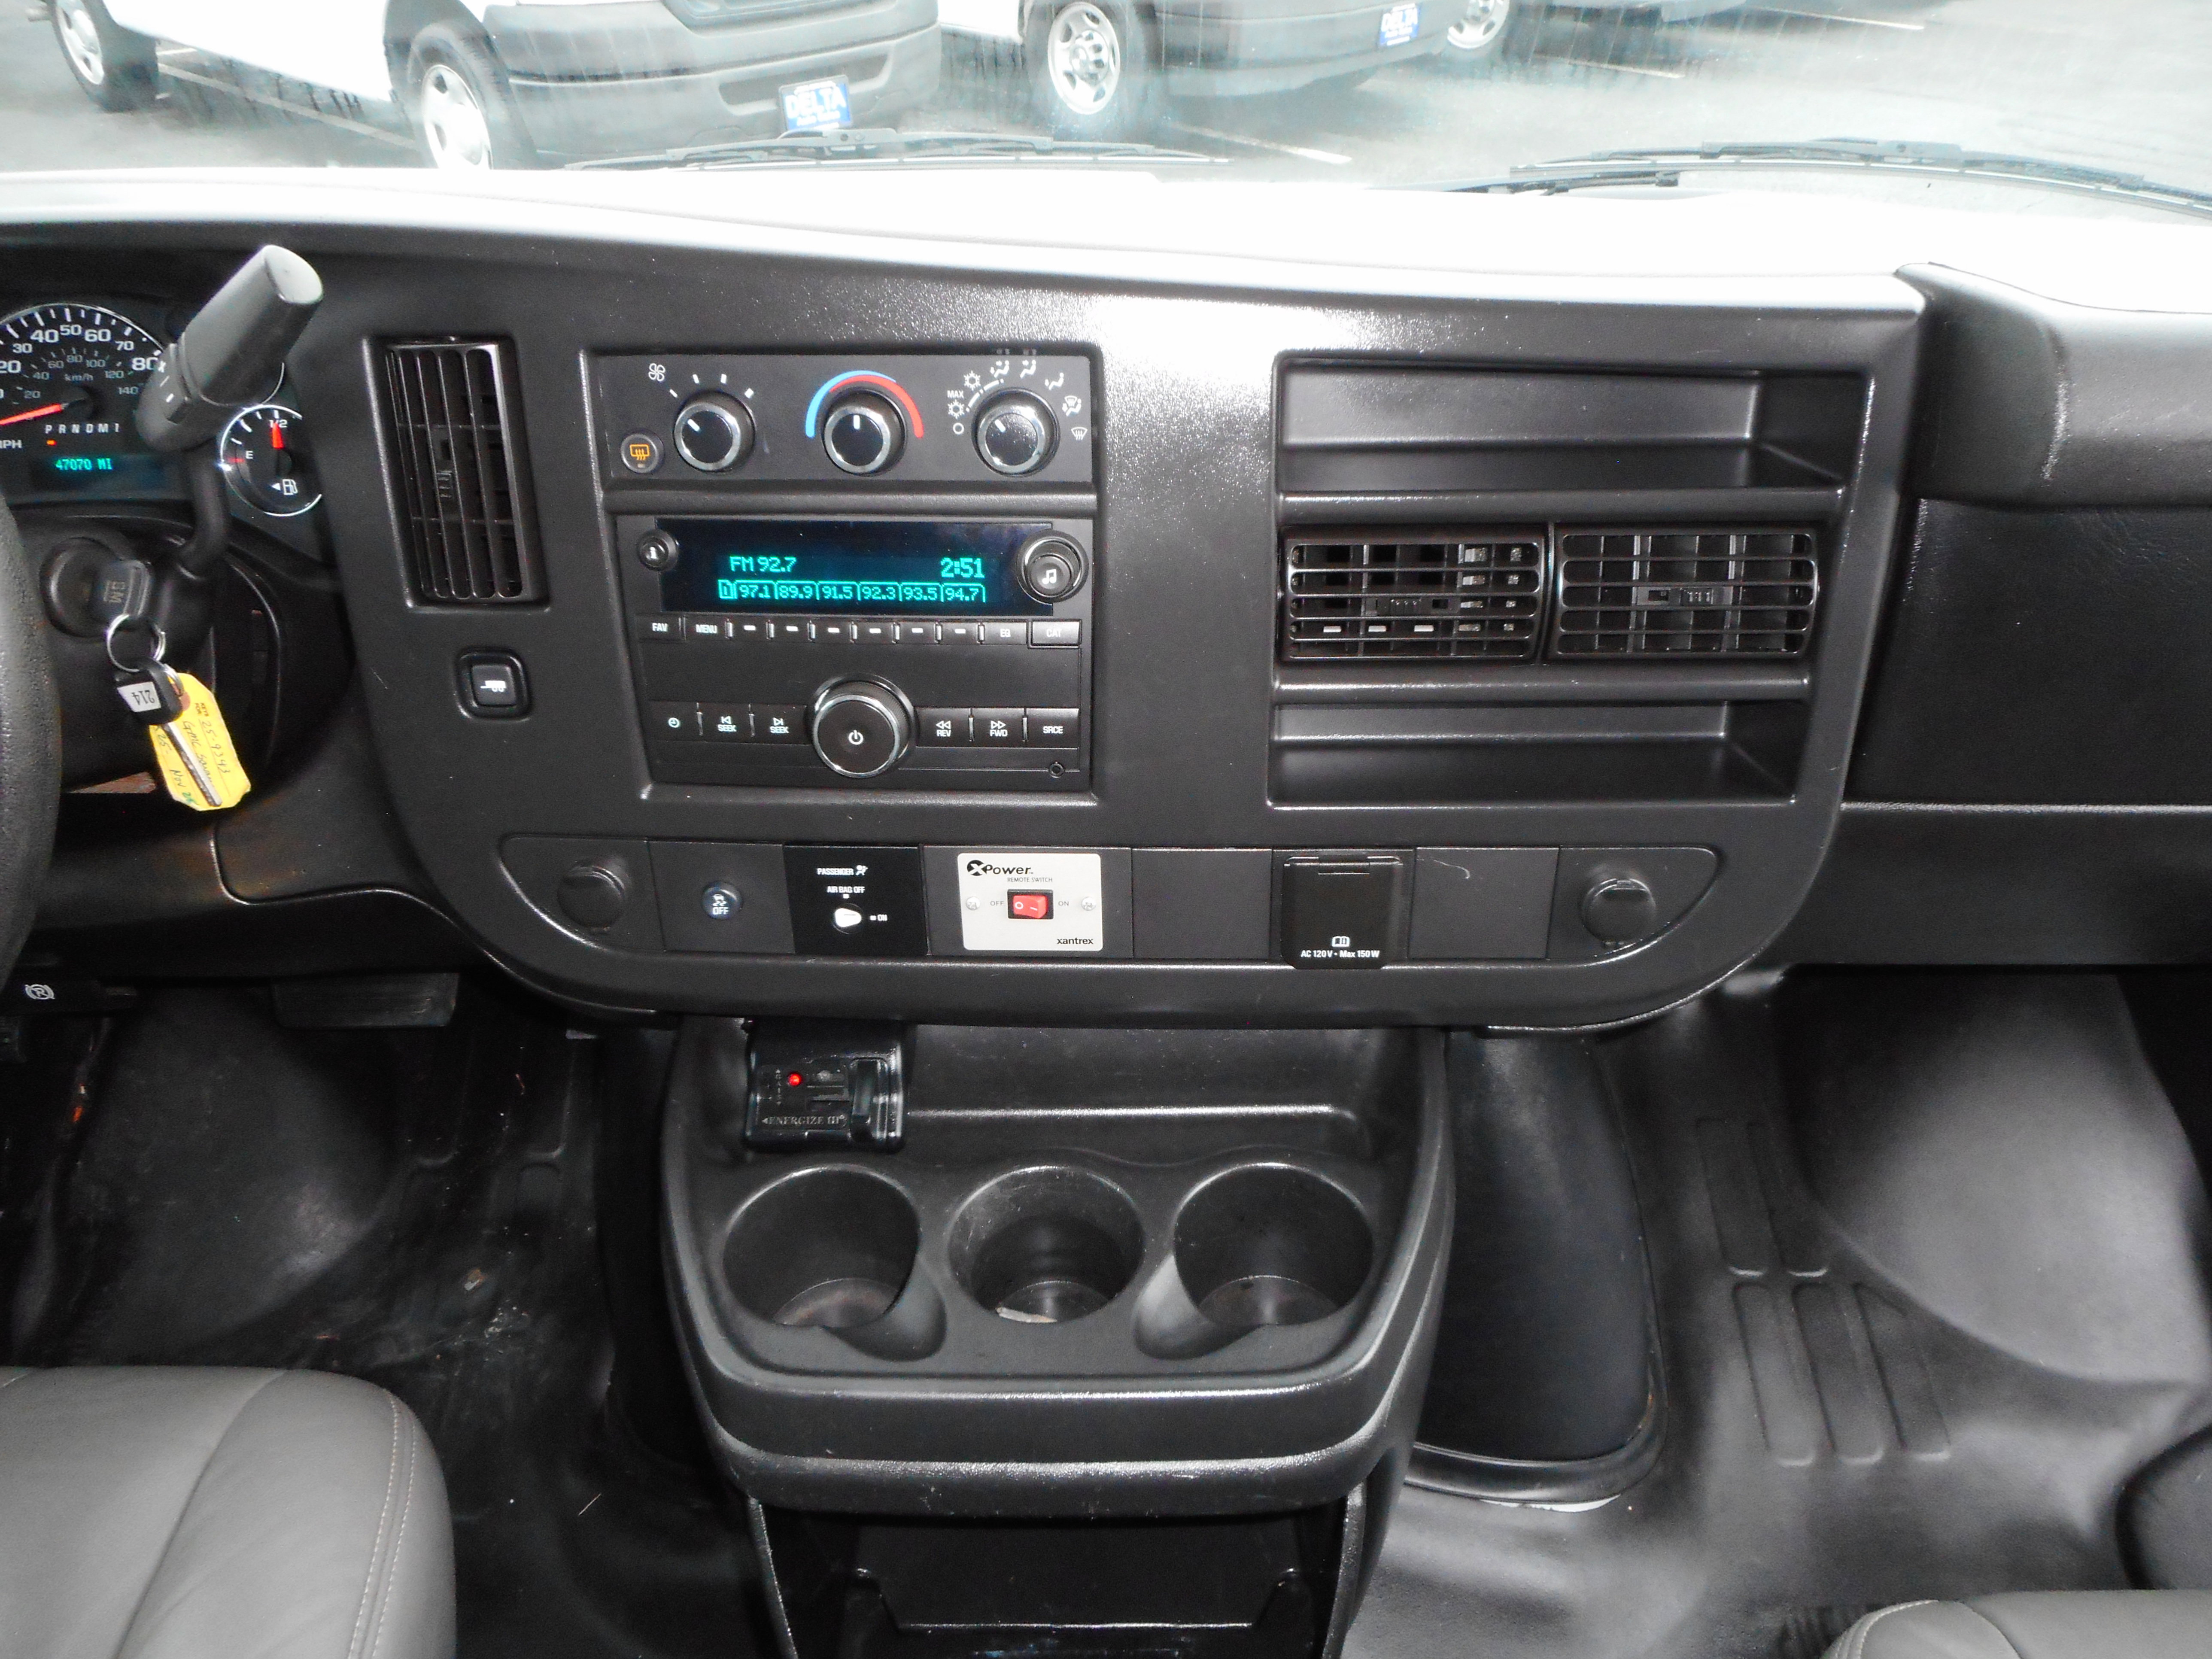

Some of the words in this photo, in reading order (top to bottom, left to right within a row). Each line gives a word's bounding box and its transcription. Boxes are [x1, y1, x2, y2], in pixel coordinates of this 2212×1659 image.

[785, 86, 846, 118] DELTA
[60, 324, 82, 336] 50
[30, 329, 59, 343] 40
[85, 329, 111, 342] 60
[12, 343, 33, 353] 30
[115, 340, 134, 351] 70
[67, 355, 83, 363] 80
[86, 359, 106, 368] 100
[0, 360, 21, 373] 20
[33, 371, 49, 380] 40
[64, 373, 94, 381] km/h
[105, 371, 124, 379] 120
[118, 386, 138, 395] 140
[947, 390, 964, 399] MAX
[246, 450, 254, 459] E
[55, 459, 92, 470] 47070
[97, 458, 112, 470] MI
[729, 556, 754, 572] FM
[757, 556, 796, 572] 92.7
[941, 557, 985, 578] 2:51
[739, 584, 771, 599] 97.1
[779, 585, 813, 599] 89.9
[822, 586, 853, 599] 91.5
[862, 586, 896, 600] 92.3
[903, 587, 938, 600] 93.5
[945, 587, 979, 601] 94.7
[652, 623, 668, 632] FAV
[696, 624, 718, 634] MENU
[1046, 629, 1062, 637] CAT
[131, 690, 155, 705] 214
[1043, 726, 1063, 734] SRCE
